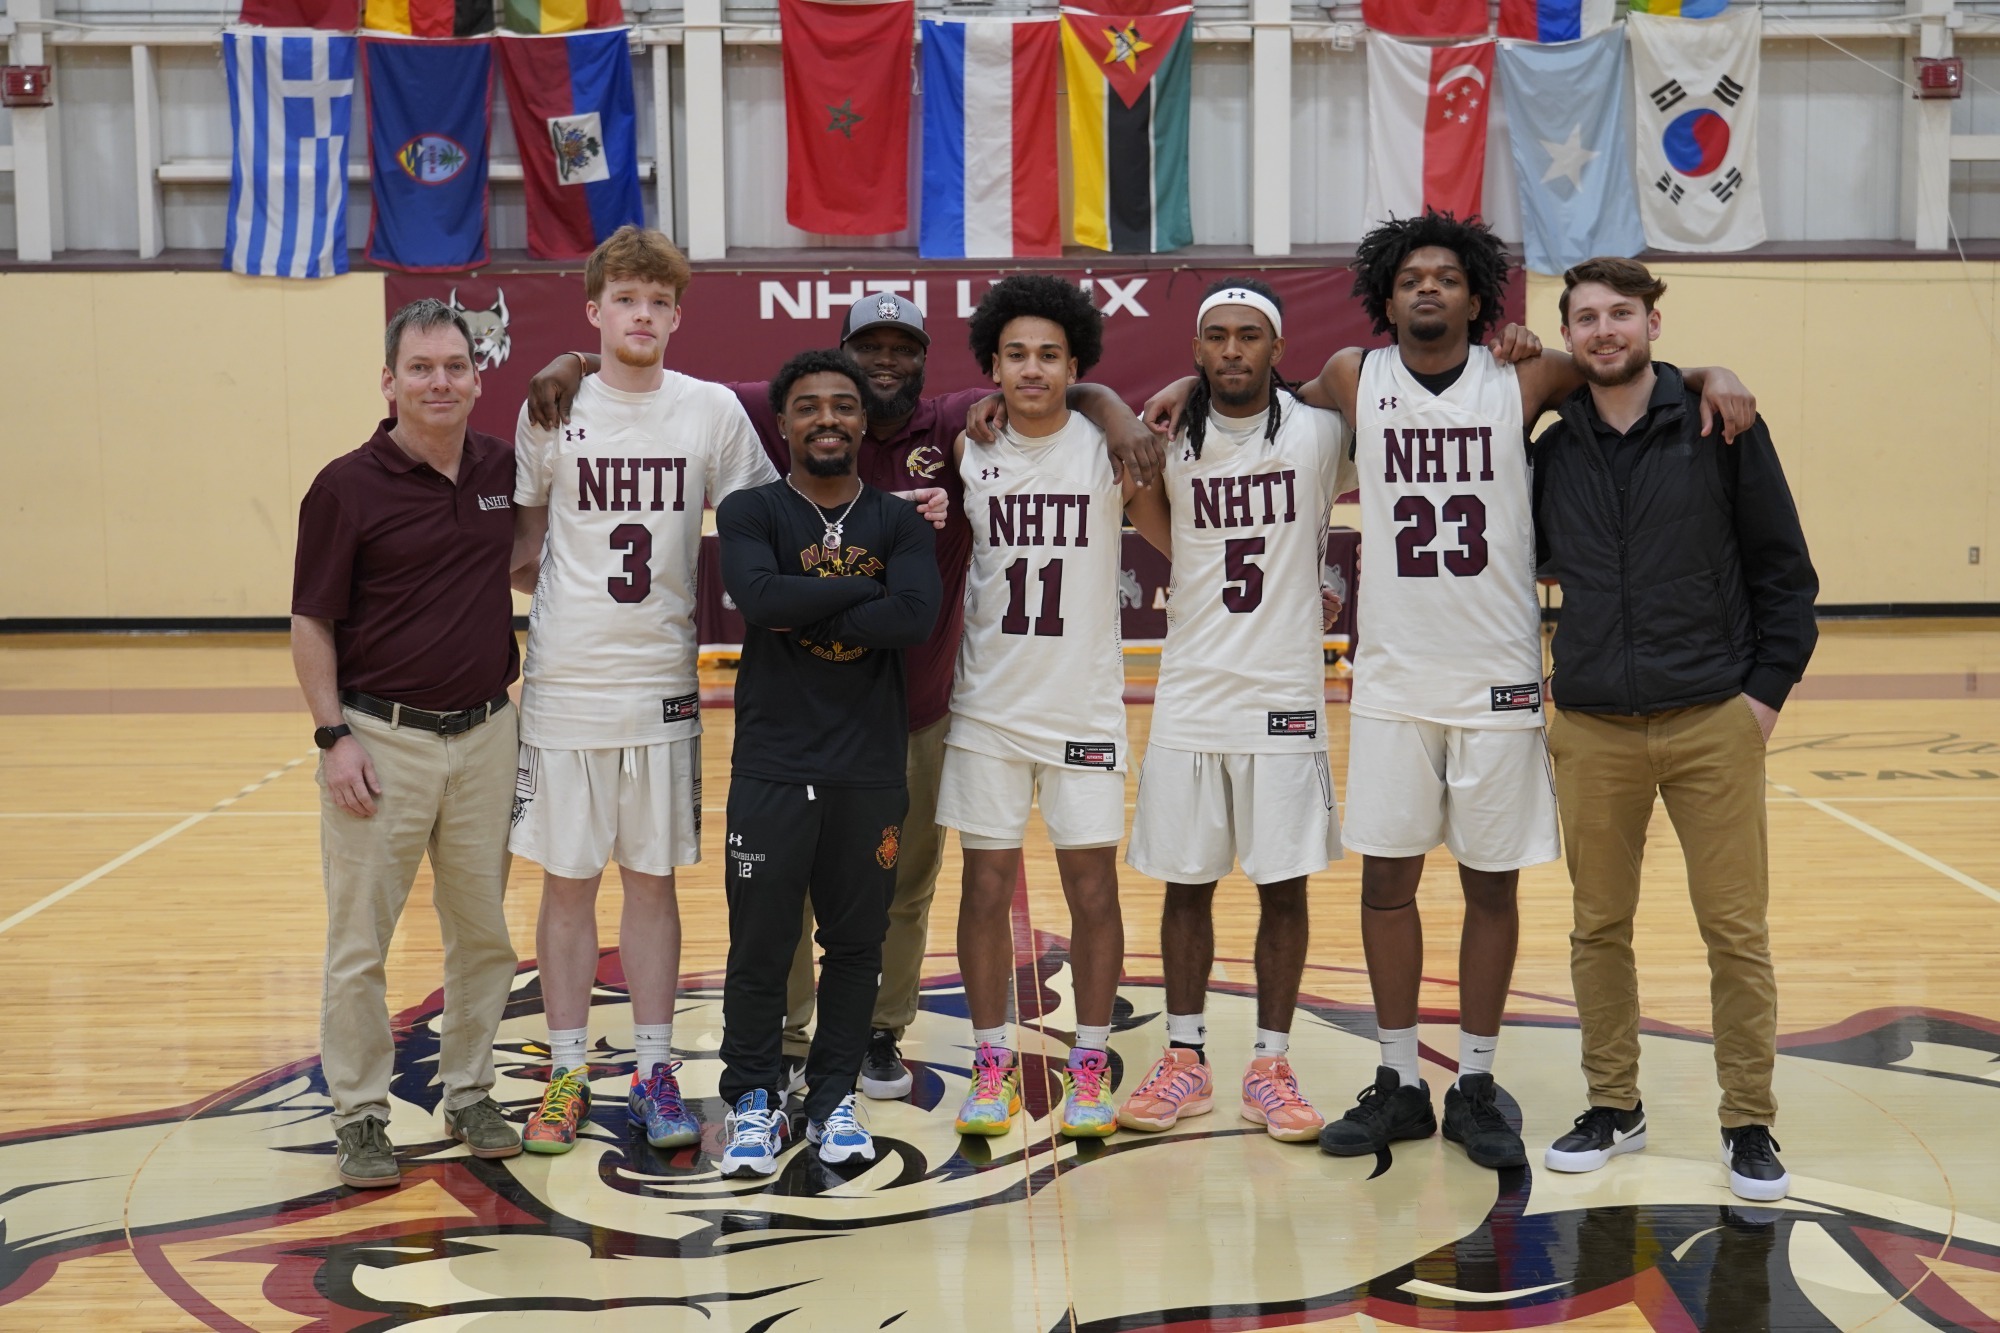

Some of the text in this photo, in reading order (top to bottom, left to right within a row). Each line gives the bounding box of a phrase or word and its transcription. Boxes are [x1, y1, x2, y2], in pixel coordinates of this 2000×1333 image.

[957, 278, 1150, 318] LX
[1384, 427, 1494, 483] NHTI
[484, 495, 509, 507] NHTI
[577, 458, 687, 511] NHTI
[1192, 470, 1296, 529] NHTI
[988, 494, 1090, 547] NHTI
[1393, 494, 1488, 577] 23
[608, 524, 652, 603] 3
[801, 544, 884, 576] NHTI
[1222, 536, 1265, 613] 5
[1002, 558, 1064, 636] 11
[738, 861, 752, 878] 12
